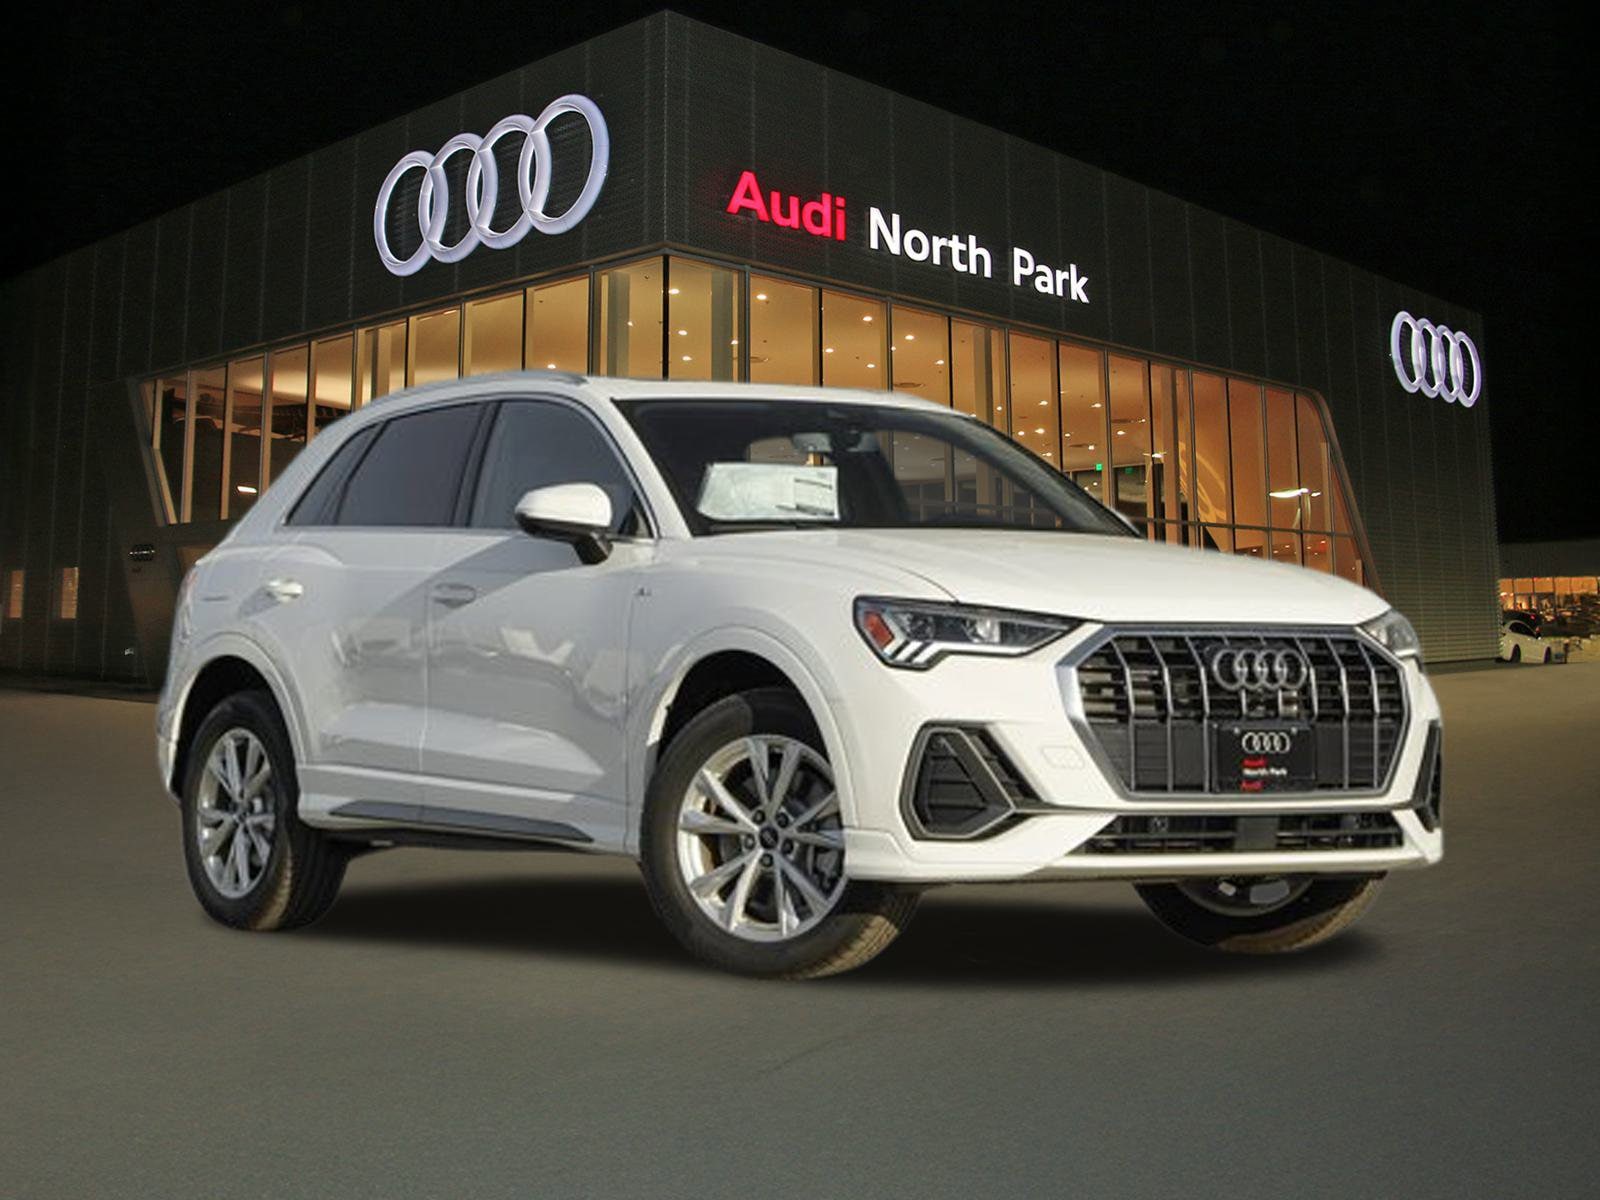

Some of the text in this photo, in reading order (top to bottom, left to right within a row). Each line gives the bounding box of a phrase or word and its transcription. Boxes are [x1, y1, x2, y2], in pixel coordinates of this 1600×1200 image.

[726, 170, 1090, 304] Audi North Park
